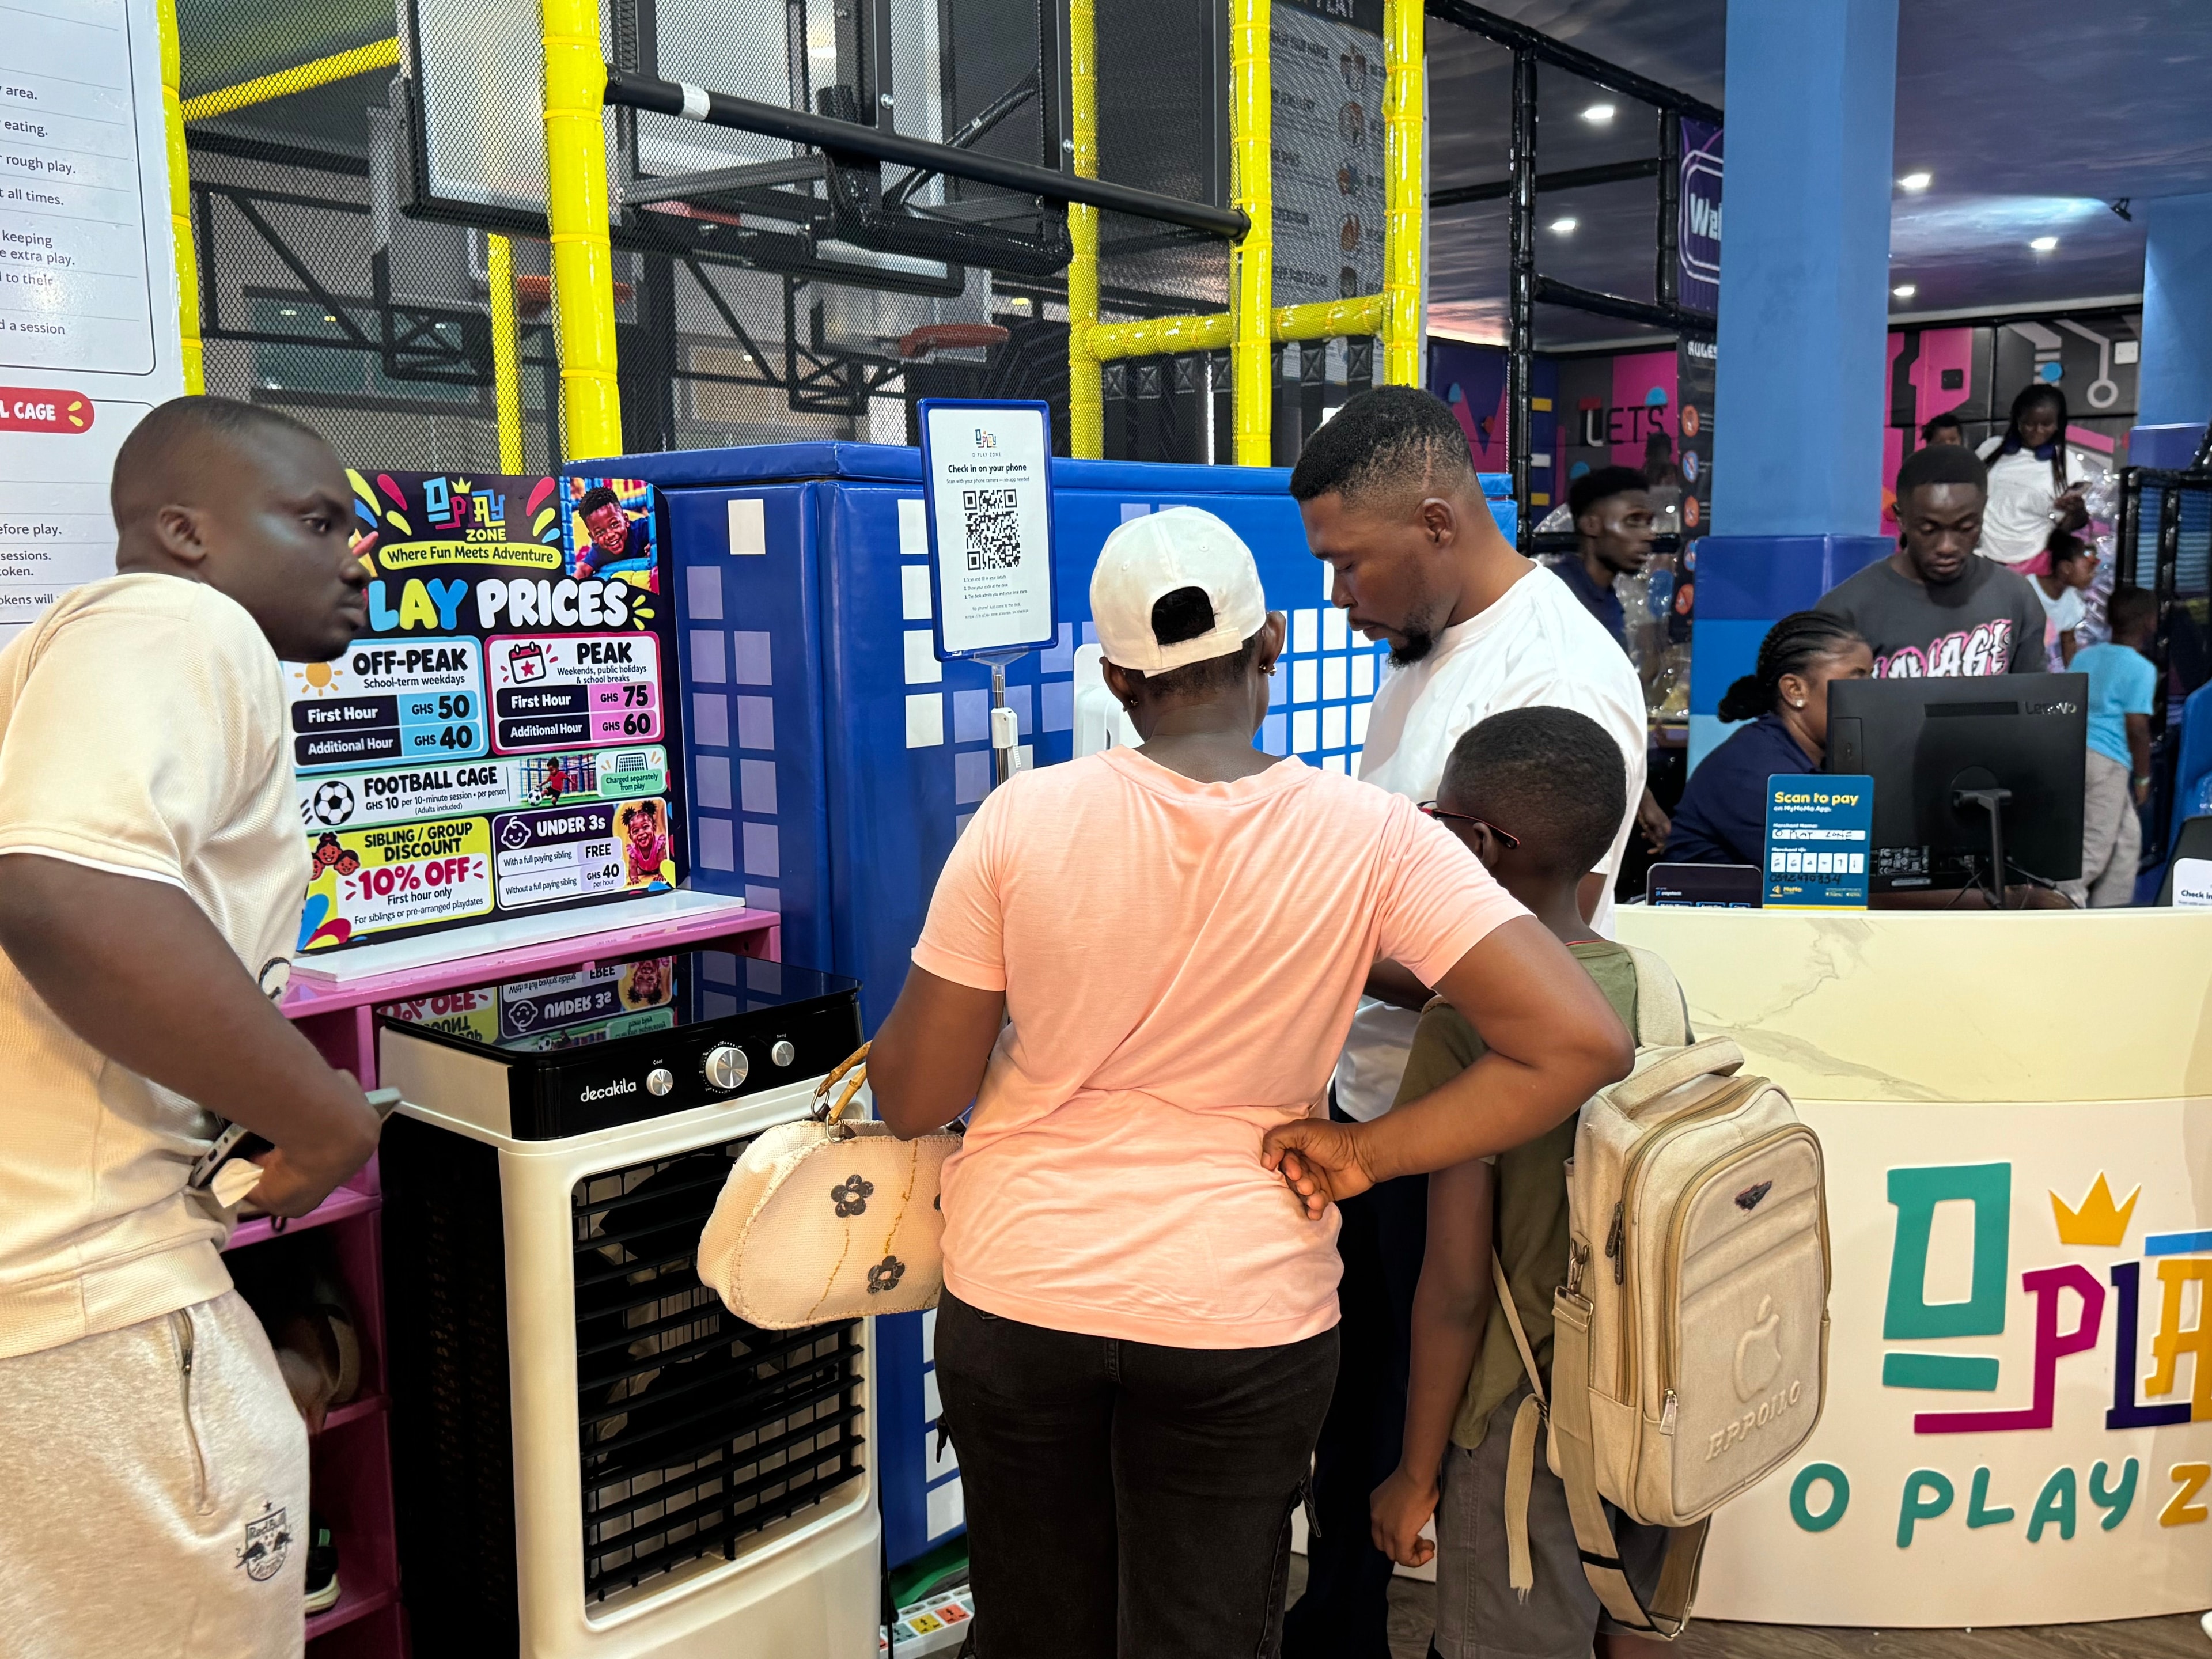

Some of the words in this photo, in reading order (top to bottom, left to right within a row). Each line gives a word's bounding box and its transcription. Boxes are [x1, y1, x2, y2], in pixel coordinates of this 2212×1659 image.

[6, 87, 37, 100] area.
[4, 121, 48, 138] eating.
[6, 156, 43, 171] rough
[48, 161, 75, 175] play.
[8, 188, 22, 200] all
[26, 191, 64, 206] times.
[2, 229, 53, 249] keeping
[10, 250, 43, 262] extra
[47, 252, 75, 267] play.
[6, 273, 19, 283] to
[23, 273, 53, 286] their
[9, 323, 17, 331] a
[20, 323, 66, 335] session
[14, 402, 56, 421] CAGE
[948, 464, 968, 473] Check
[970, 464, 976, 472] in
[989, 465, 1004, 474] your
[1006, 463, 1027, 474] phone
[33, 524, 62, 537] play.
[465, 528, 507, 541] ZONE
[1, 551, 51, 560] sessions.
[388, 548, 427, 563] Where
[430, 546, 451, 559] Fun
[454, 546, 489, 559] Meets
[493, 547, 554, 563] Adventure
[35, 594, 54, 604] will
[368, 578, 468, 632] LAY
[476, 578, 628, 629] PRICES
[353, 648, 468, 676] OFF-PEAK
[577, 642, 633, 665] PEAK
[557, 667, 596, 676] Weekends,
[597, 666, 618, 676] public
[619, 665, 647, 675] holidays
[364, 677, 419, 689] School-term
[421, 674, 465, 687] weekdays
[576, 676, 581, 684] &
[583, 675, 605, 684] school
[607, 675, 630, 683] breaks
[511, 695, 540, 709] First
[541, 694, 571, 707] Hour
[600, 693, 619, 703] GHS
[623, 685, 649, 707] 75
[411, 703, 434, 715] GHS
[438, 694, 471, 719] 50
[308, 709, 341, 724] First
[344, 707, 378, 721] Hour
[510, 724, 559, 738] Additional
[560, 724, 582, 735] Hour
[602, 722, 620, 732] GHS
[623, 713, 651, 736] 60
[414, 735, 437, 747] GHS
[440, 725, 473, 750] 40
[308, 738, 365, 756] Additional
[366, 737, 394, 750] Hour
[364, 770, 453, 797] FOOTBALL
[456, 766, 498, 787] CAGE
[606, 775, 629, 785] Charged
[630, 773, 658, 783] separately
[634, 783, 645, 791] play
[366, 801, 383, 811] GHS
[385, 797, 399, 810] 10
[402, 798, 412, 808] per
[415, 794, 449, 805] 10-minute
[449, 791, 472, 801] session
[478, 790, 487, 800] per
[488, 789, 506, 798] person
[1775, 791, 1810, 803] Scan
[1814, 793, 1829, 803] to
[1832, 795, 1859, 806] pay
[415, 805, 435, 815] (Adults
[437, 802, 463, 813] included)
[536, 816, 585, 837] UNDER
[589, 815, 605, 831] 3s
[365, 829, 415, 848] SIBLING
[418, 827, 423, 842] /
[427, 822, 472, 839] GROUP
[384, 838, 461, 862] DISCOUNT
[585, 843, 611, 858] FREE
[503, 858, 518, 867] With
[524, 855, 533, 864] full
[534, 853, 553, 865] paying
[554, 851, 572, 860] sibling
[358, 864, 421, 900] 10%
[425, 856, 470, 887] OFF
[587, 872, 601, 881] GHS
[603, 863, 619, 878] 40
[506, 885, 528, 895] Without
[533, 882, 542, 891] full
[543, 880, 560, 892] paying
[560, 877, 577, 887] sibling
[2181, 890, 2204, 899] Check
[388, 895, 408, 906] First
[411, 889, 432, 902] hour
[434, 887, 452, 899] only
[354, 915, 366, 925] For
[369, 911, 396, 923] siblings
[406, 902, 450, 918] pre-arranged
[452, 897, 483, 911] playdates
[580, 1078, 637, 1103] decakila
[1790, 1461, 1850, 1532] O
[1896, 1456, 2140, 1549] PLAY
